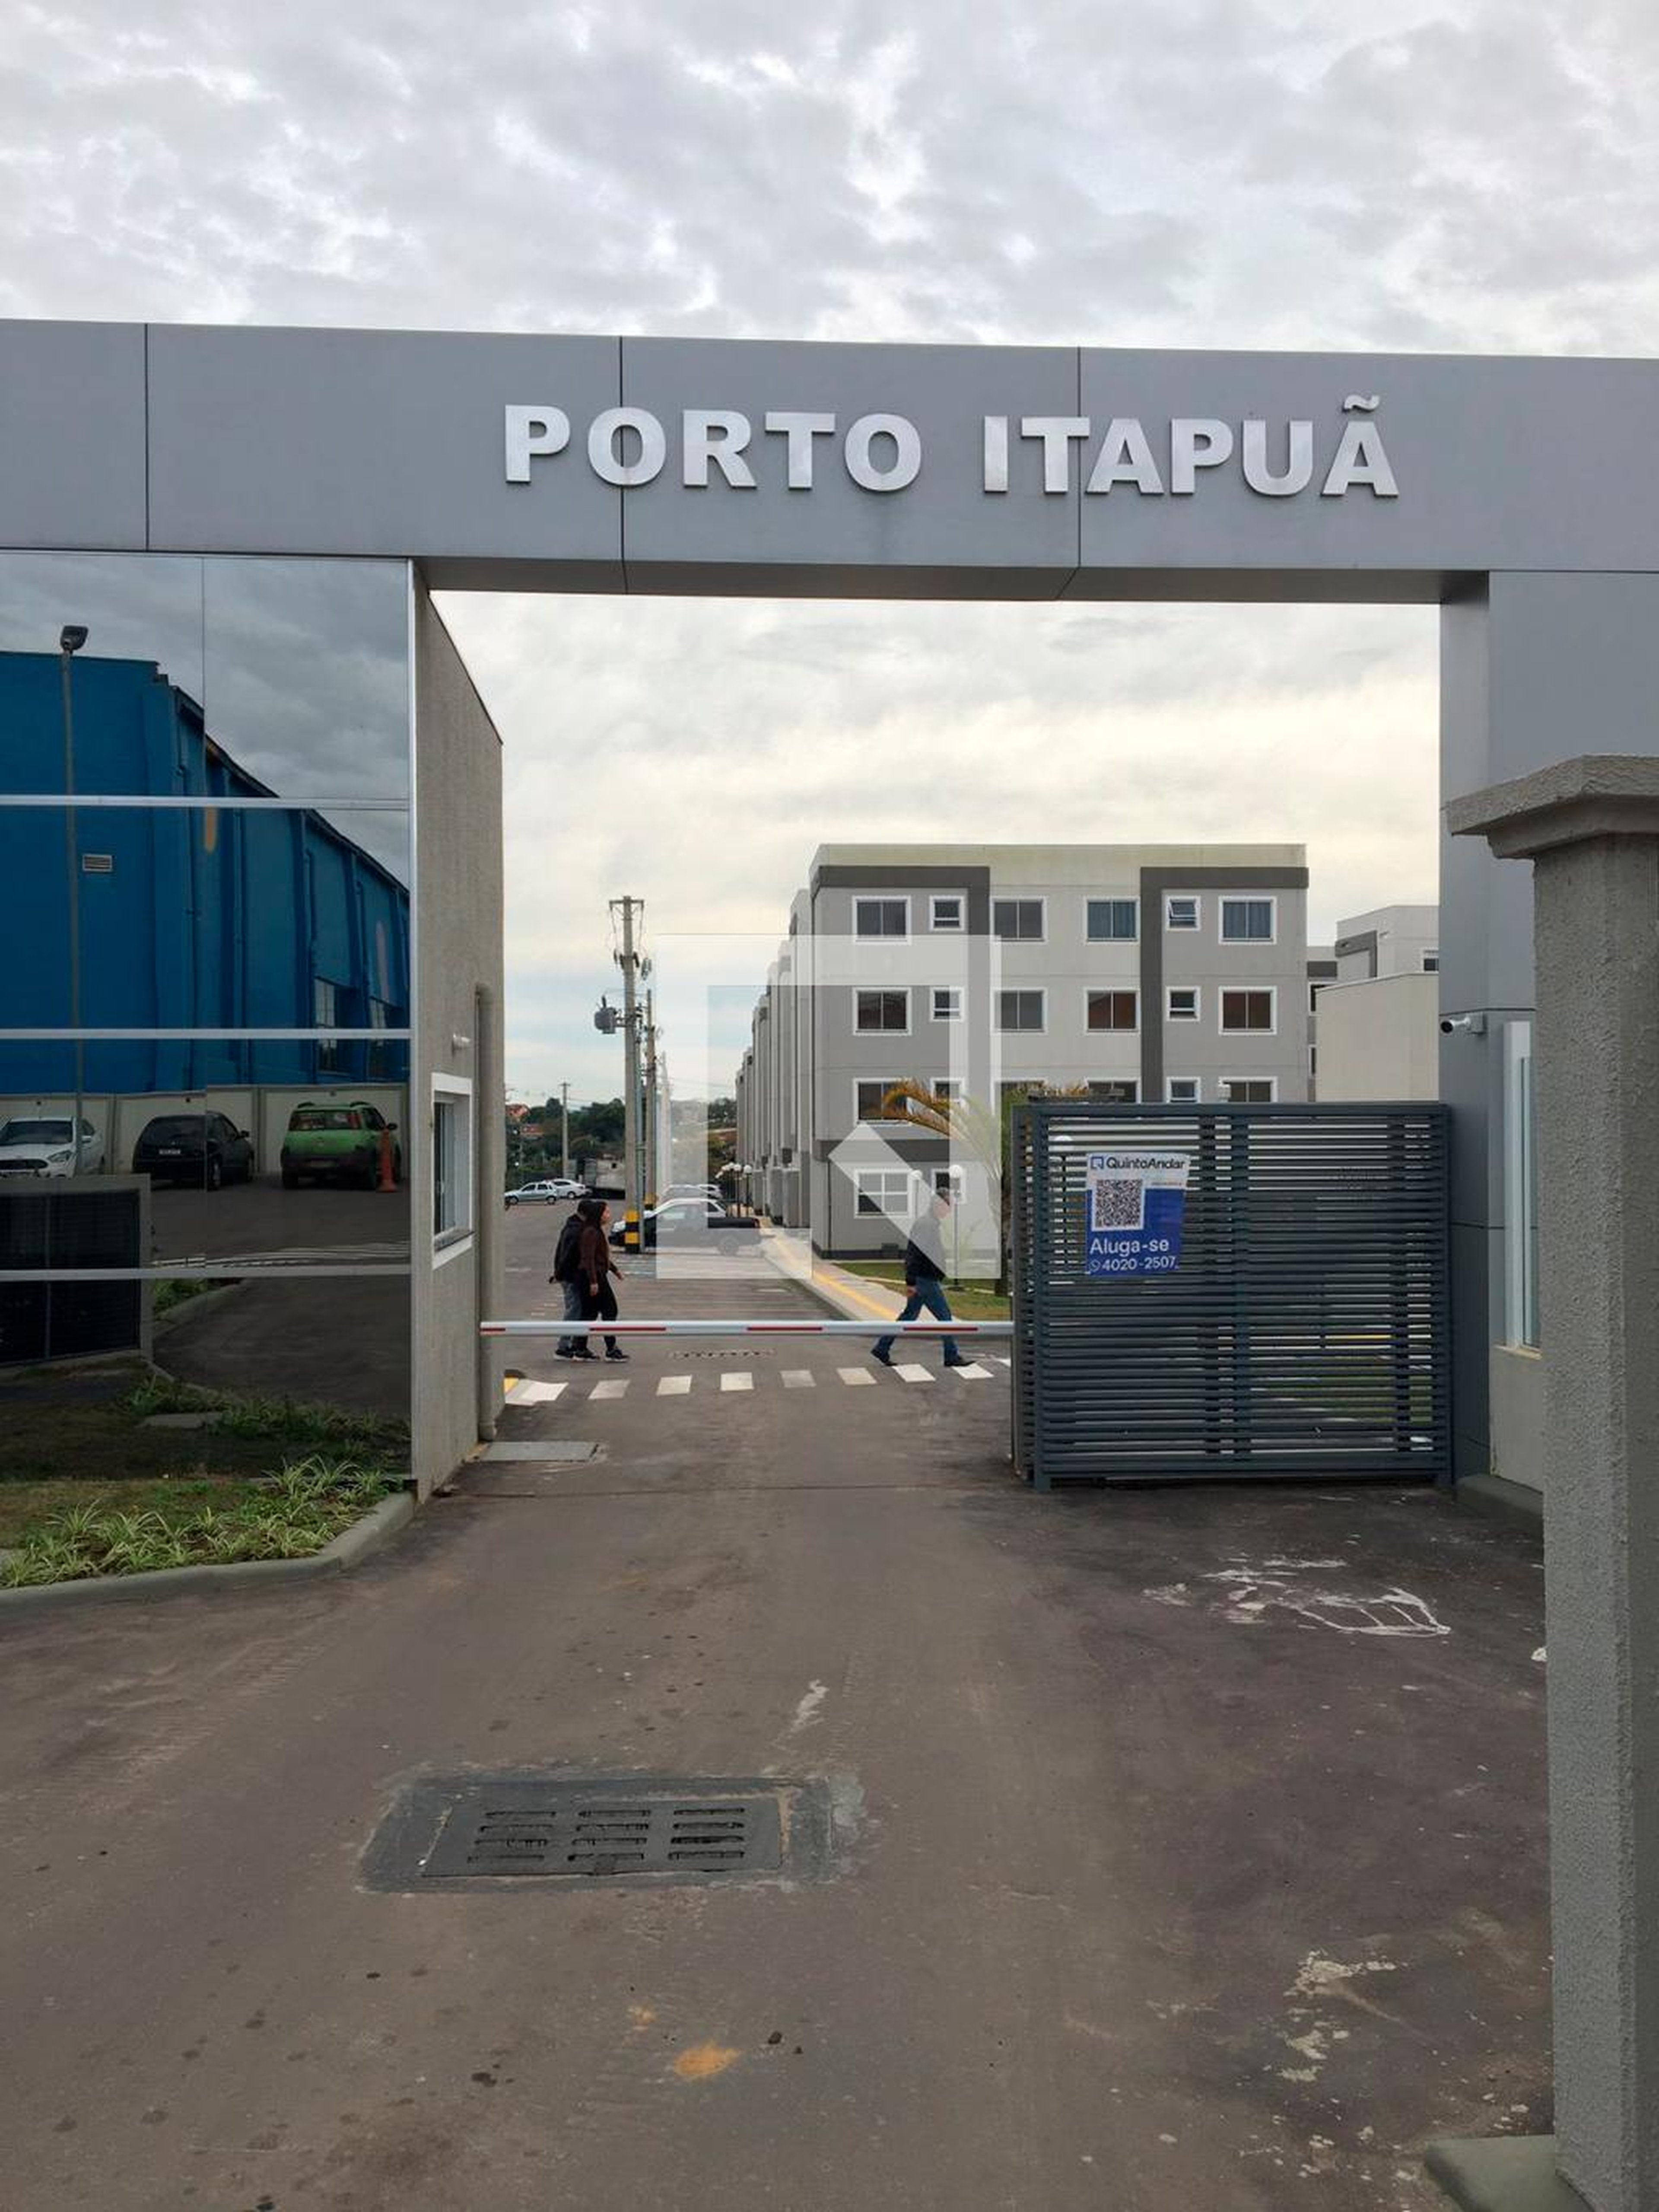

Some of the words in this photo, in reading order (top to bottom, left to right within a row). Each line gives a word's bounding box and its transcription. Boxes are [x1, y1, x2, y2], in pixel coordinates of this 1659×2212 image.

[505, 404, 922, 492] PORTO
[984, 394, 1399, 497] ITAPUÃ
[1106, 1156, 1185, 1169] QuintoAndar
[1090, 1238, 1169, 1257] Aluga-se
